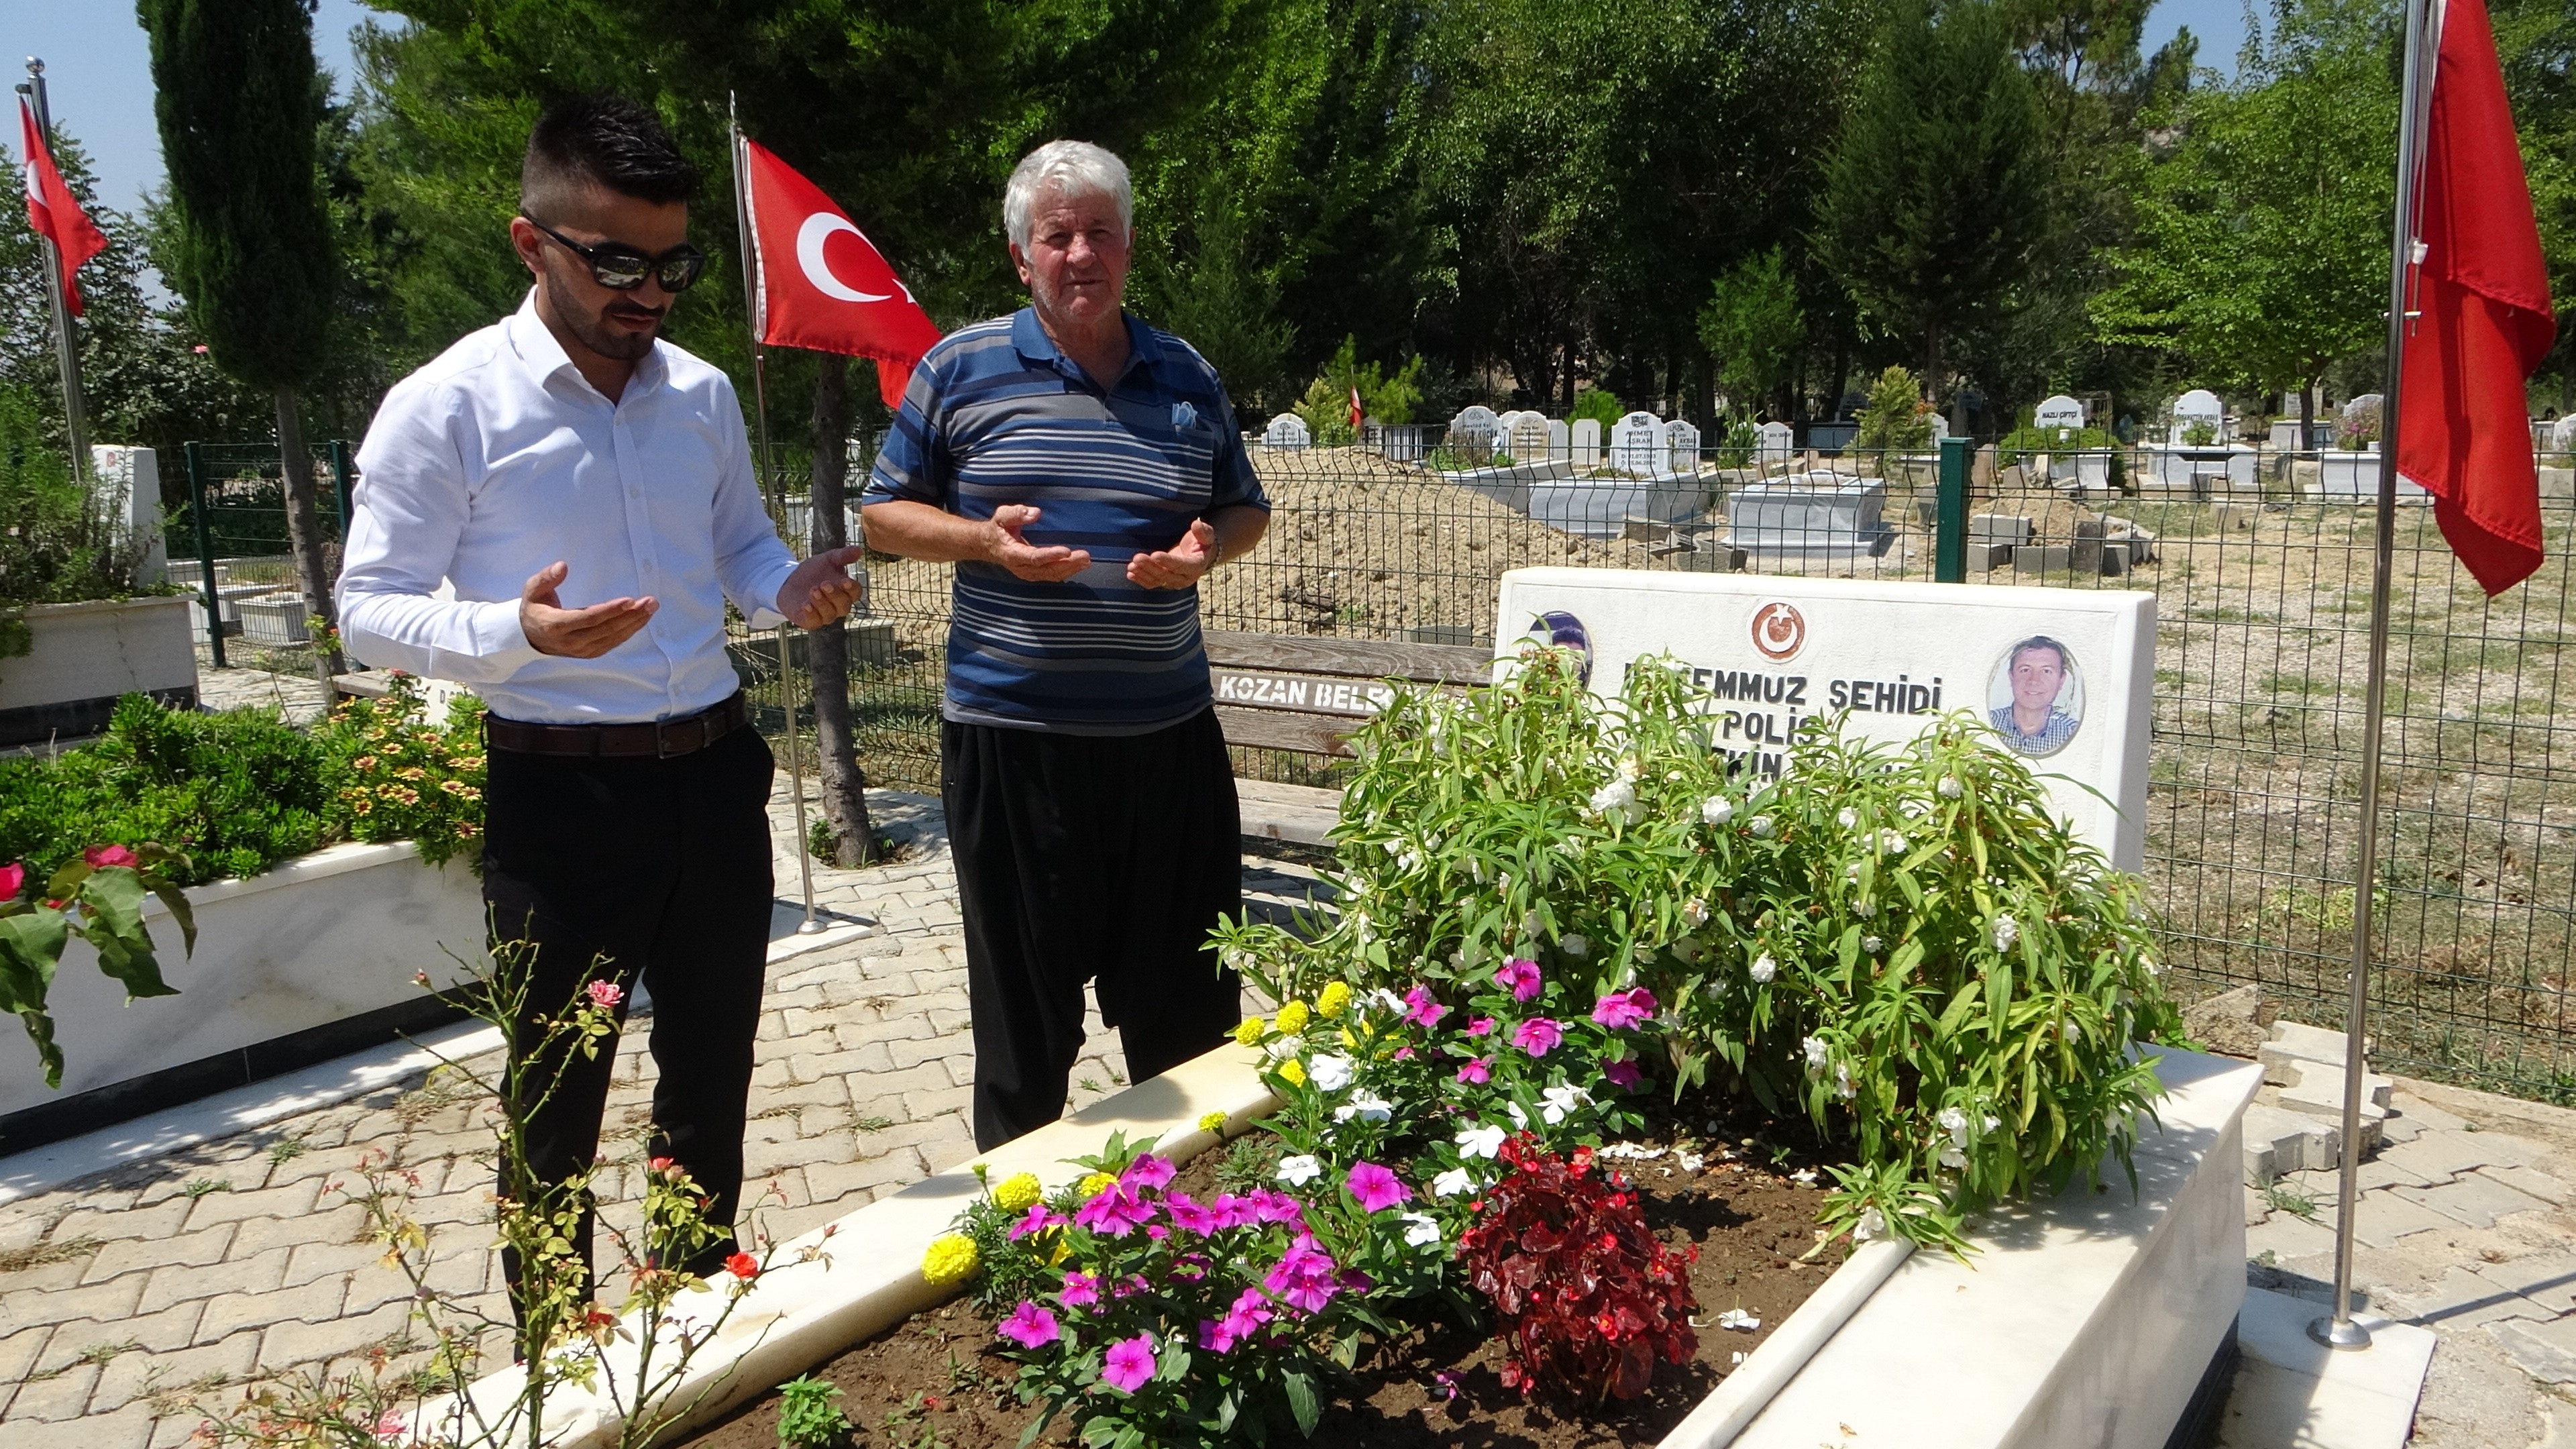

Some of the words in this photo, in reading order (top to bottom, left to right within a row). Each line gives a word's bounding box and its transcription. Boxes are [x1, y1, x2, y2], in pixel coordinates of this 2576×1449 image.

[1219, 676, 1307, 705] KOZAN
[1684, 667, 1807, 706] EMMUZ
[1829, 674, 1943, 716] ŞEHİDİ
[1722, 706, 1817, 745] POLİS
